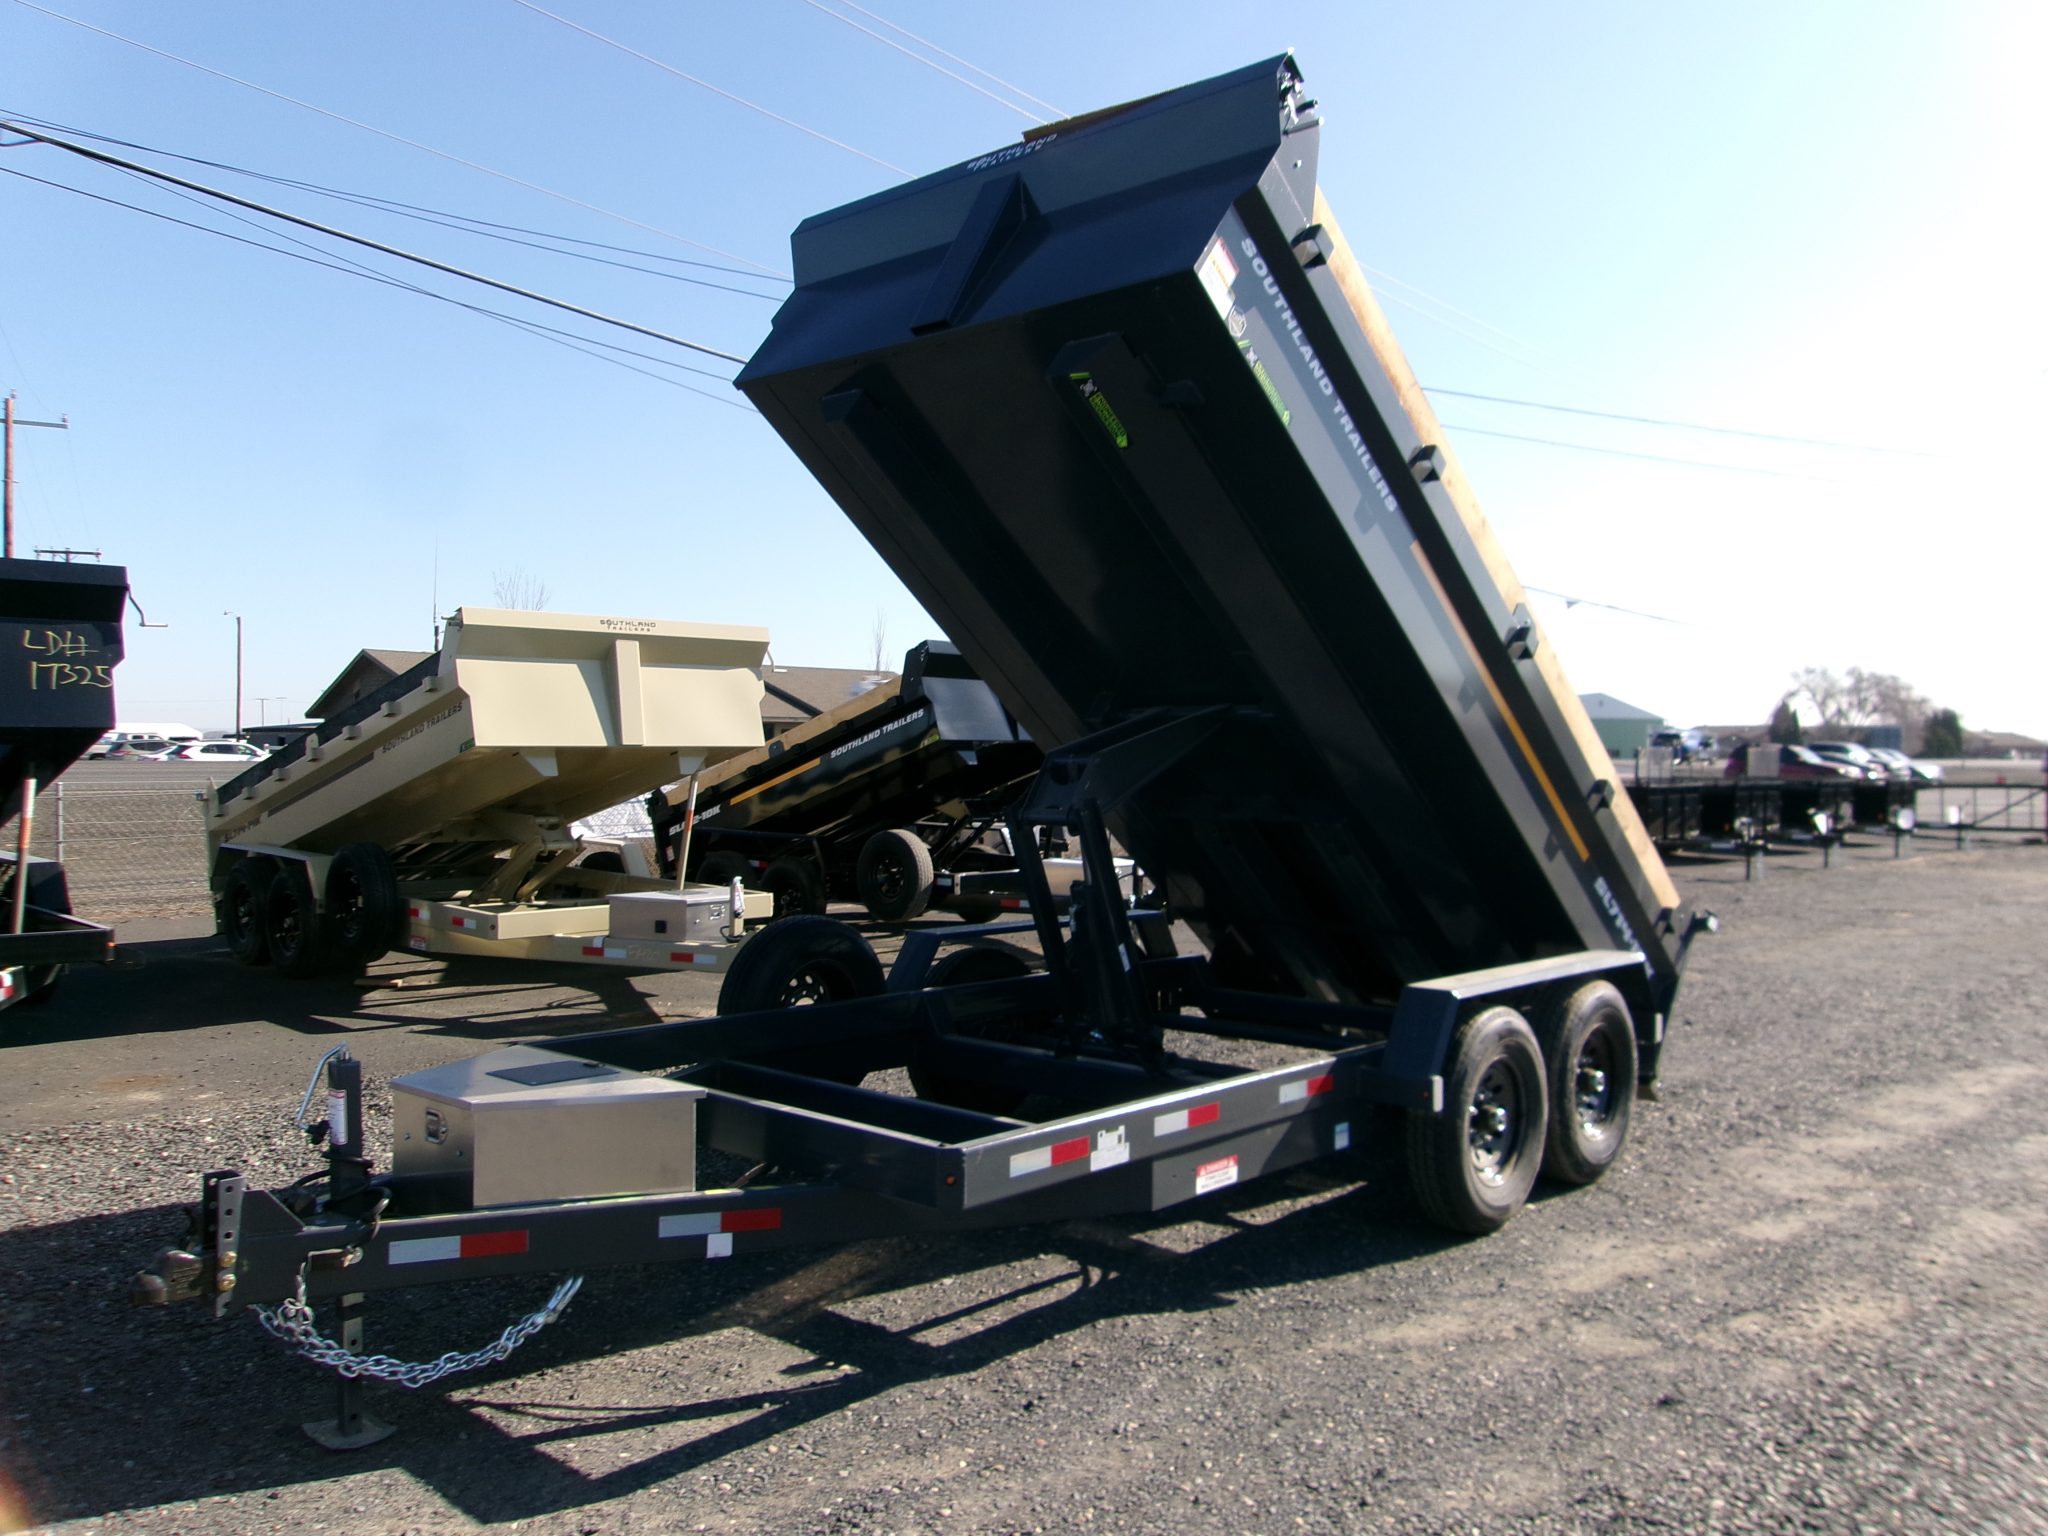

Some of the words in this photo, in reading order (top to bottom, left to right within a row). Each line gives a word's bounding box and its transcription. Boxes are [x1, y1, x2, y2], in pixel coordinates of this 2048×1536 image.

[967, 133, 1057, 170] SOUTHLAND
[973, 145, 1044, 171] TRAILERS
[1241, 237, 1334, 395] SOUTHLAND
[1332, 401, 1399, 513] TRAILERS
[600, 619, 656, 628] SOUTHLAND
[382, 721, 425, 754] SOUTHLAND
[427, 702, 463, 729] TRAILERS
[830, 727, 881, 759] SOUTHLAND
[882, 708, 925, 735] TRAILERS
